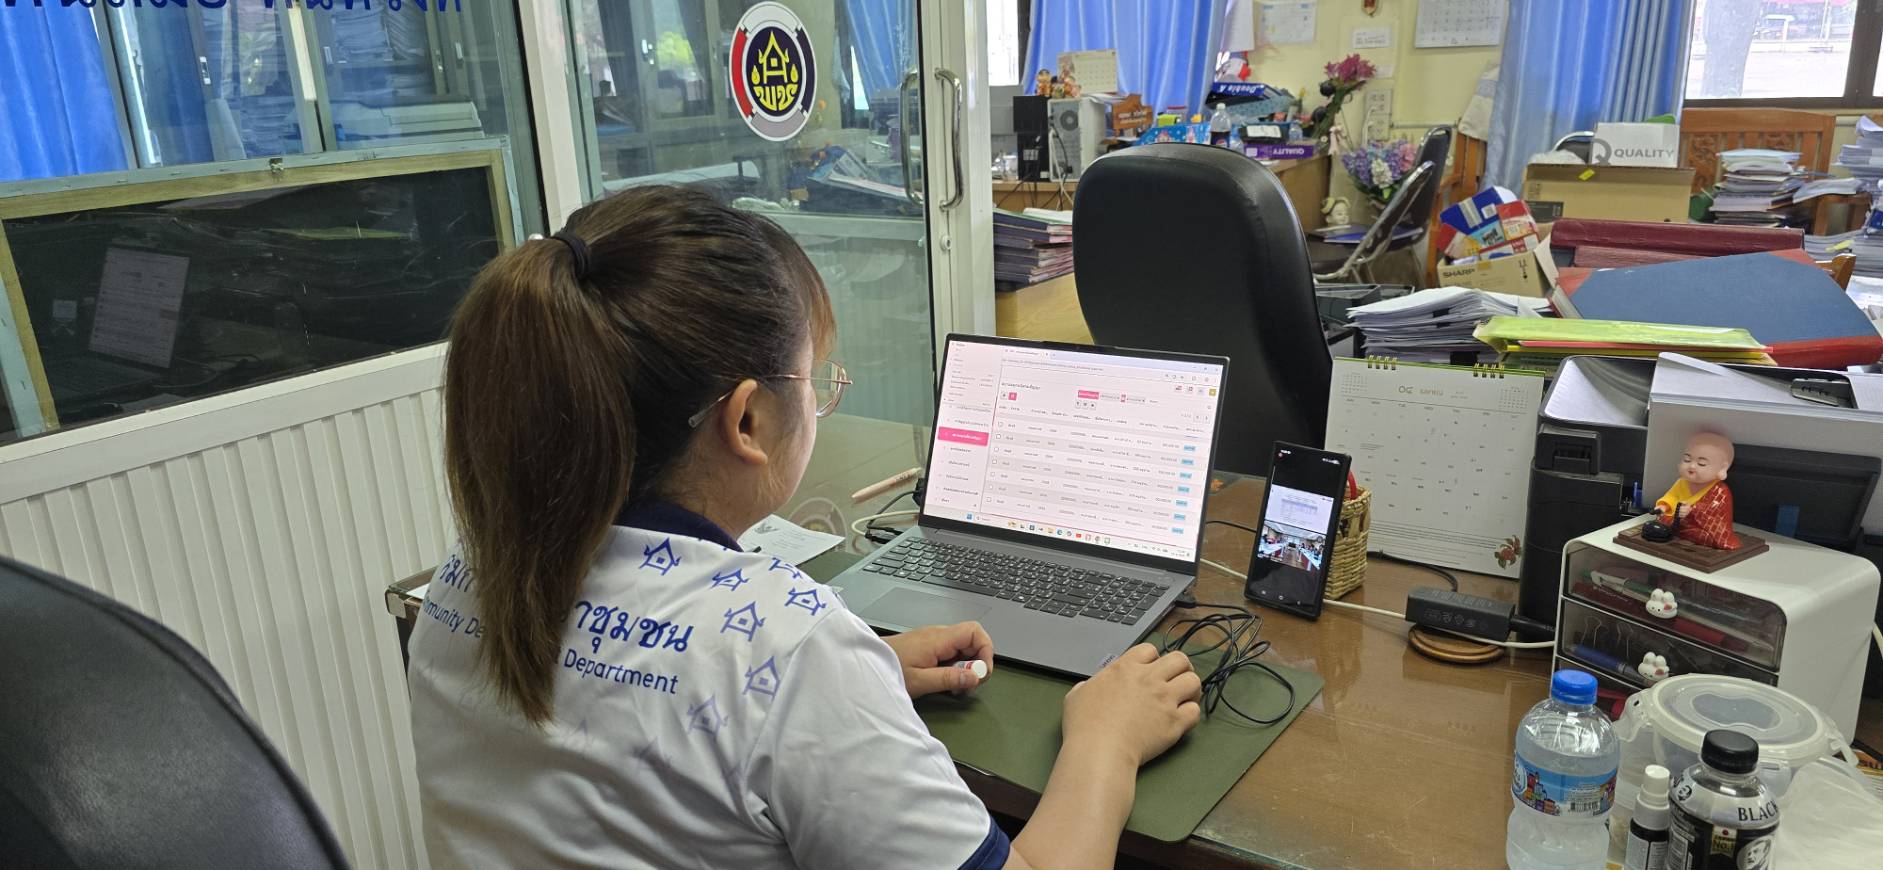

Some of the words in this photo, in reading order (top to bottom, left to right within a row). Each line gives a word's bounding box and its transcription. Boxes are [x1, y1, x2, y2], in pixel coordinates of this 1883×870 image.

[1272, 147, 1305, 156] QUALITY
[1614, 148, 1674, 158] QUALITY
[1442, 268, 1475, 278] SHARP
[575, 600, 694, 654] าชุมชน
[564, 648, 679, 694] Department
